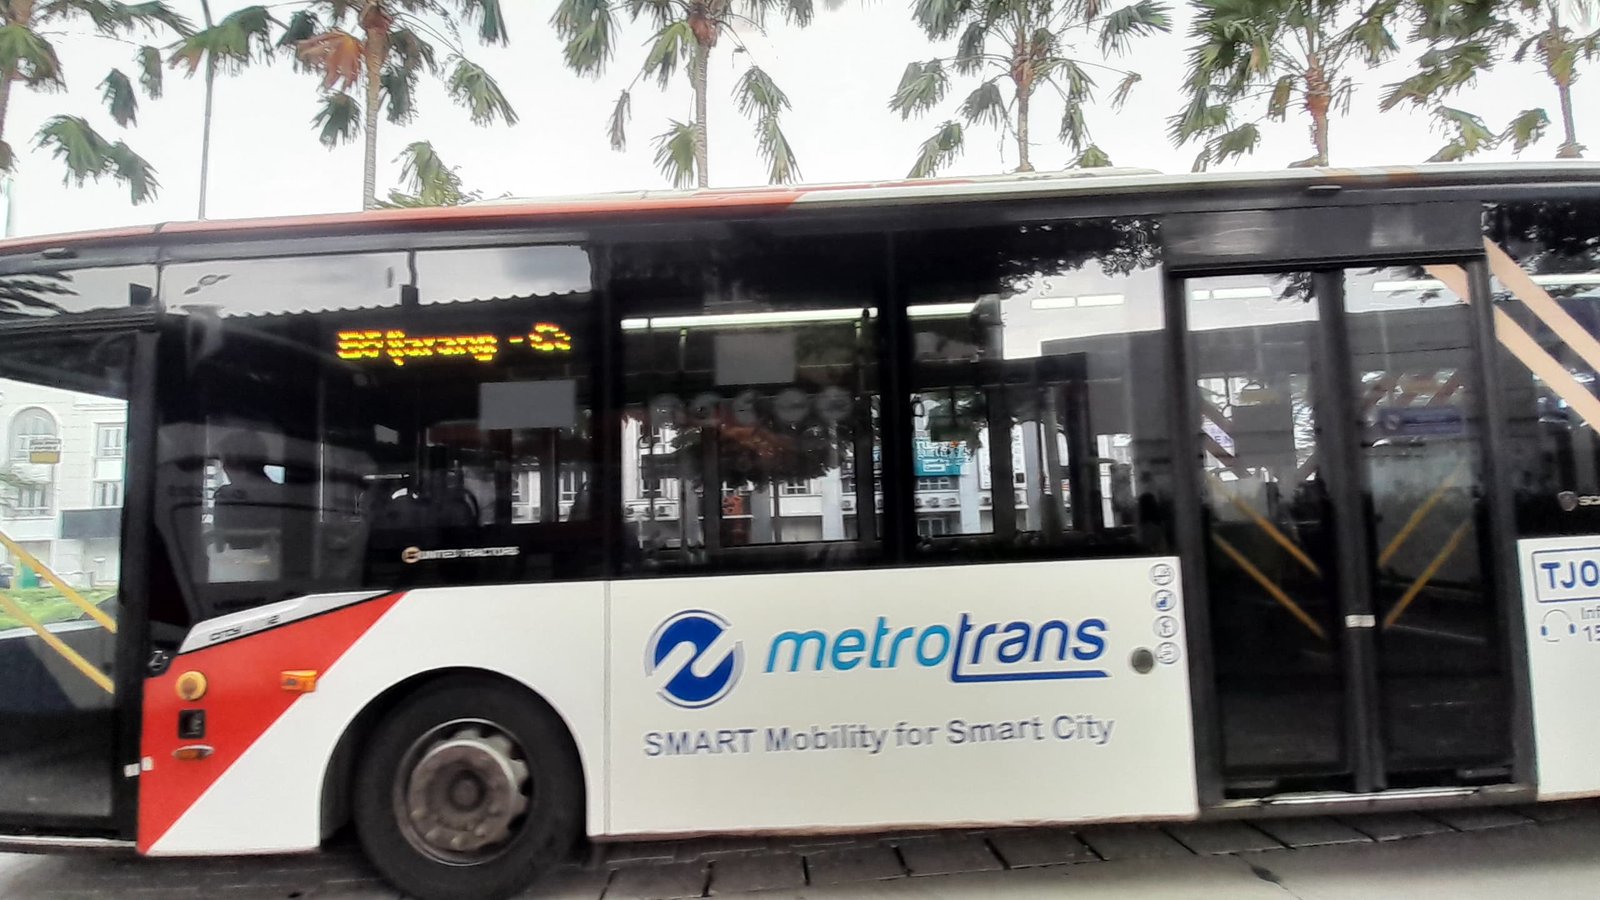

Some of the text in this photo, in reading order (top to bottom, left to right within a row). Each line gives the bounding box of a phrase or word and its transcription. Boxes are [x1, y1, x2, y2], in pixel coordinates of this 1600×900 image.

[764, 613, 1111, 682] metrotrans
[643, 714, 1115, 757] SMART Mobility for Smart City
